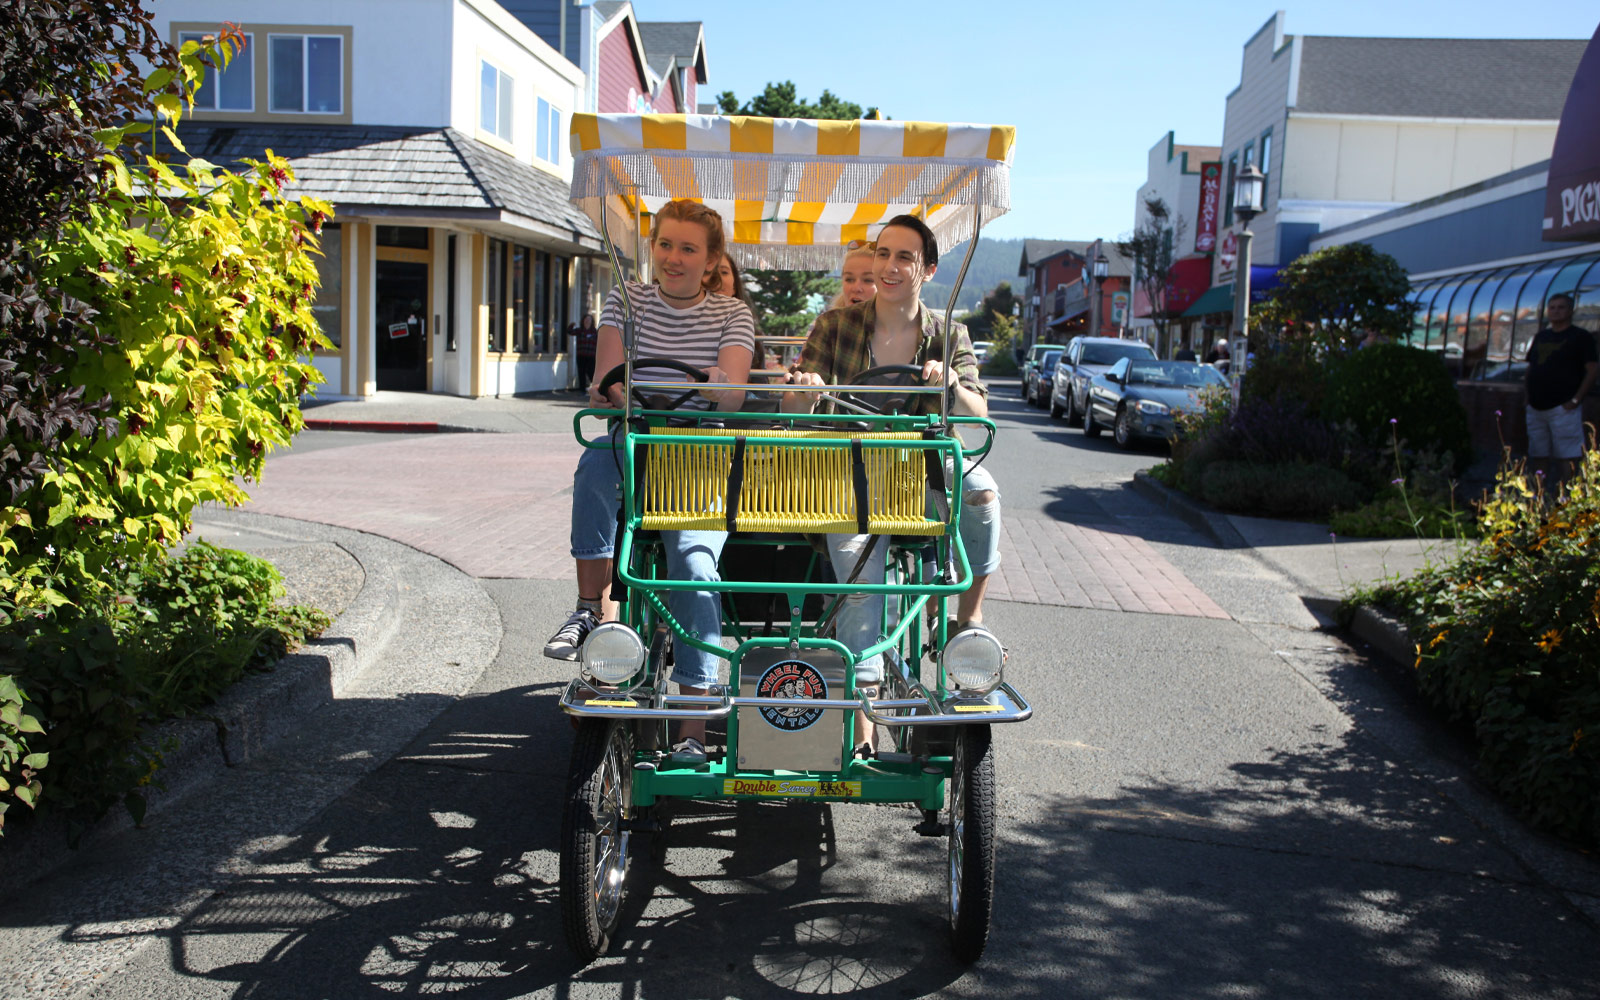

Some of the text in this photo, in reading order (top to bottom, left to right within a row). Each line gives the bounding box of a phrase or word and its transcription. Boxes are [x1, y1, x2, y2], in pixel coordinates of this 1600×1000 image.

[761, 665, 823, 694] WHEEL FUN
[763, 706, 820, 727] ENTAL
[733, 780, 777, 793] Double
[777, 782, 817, 796] Surrey
